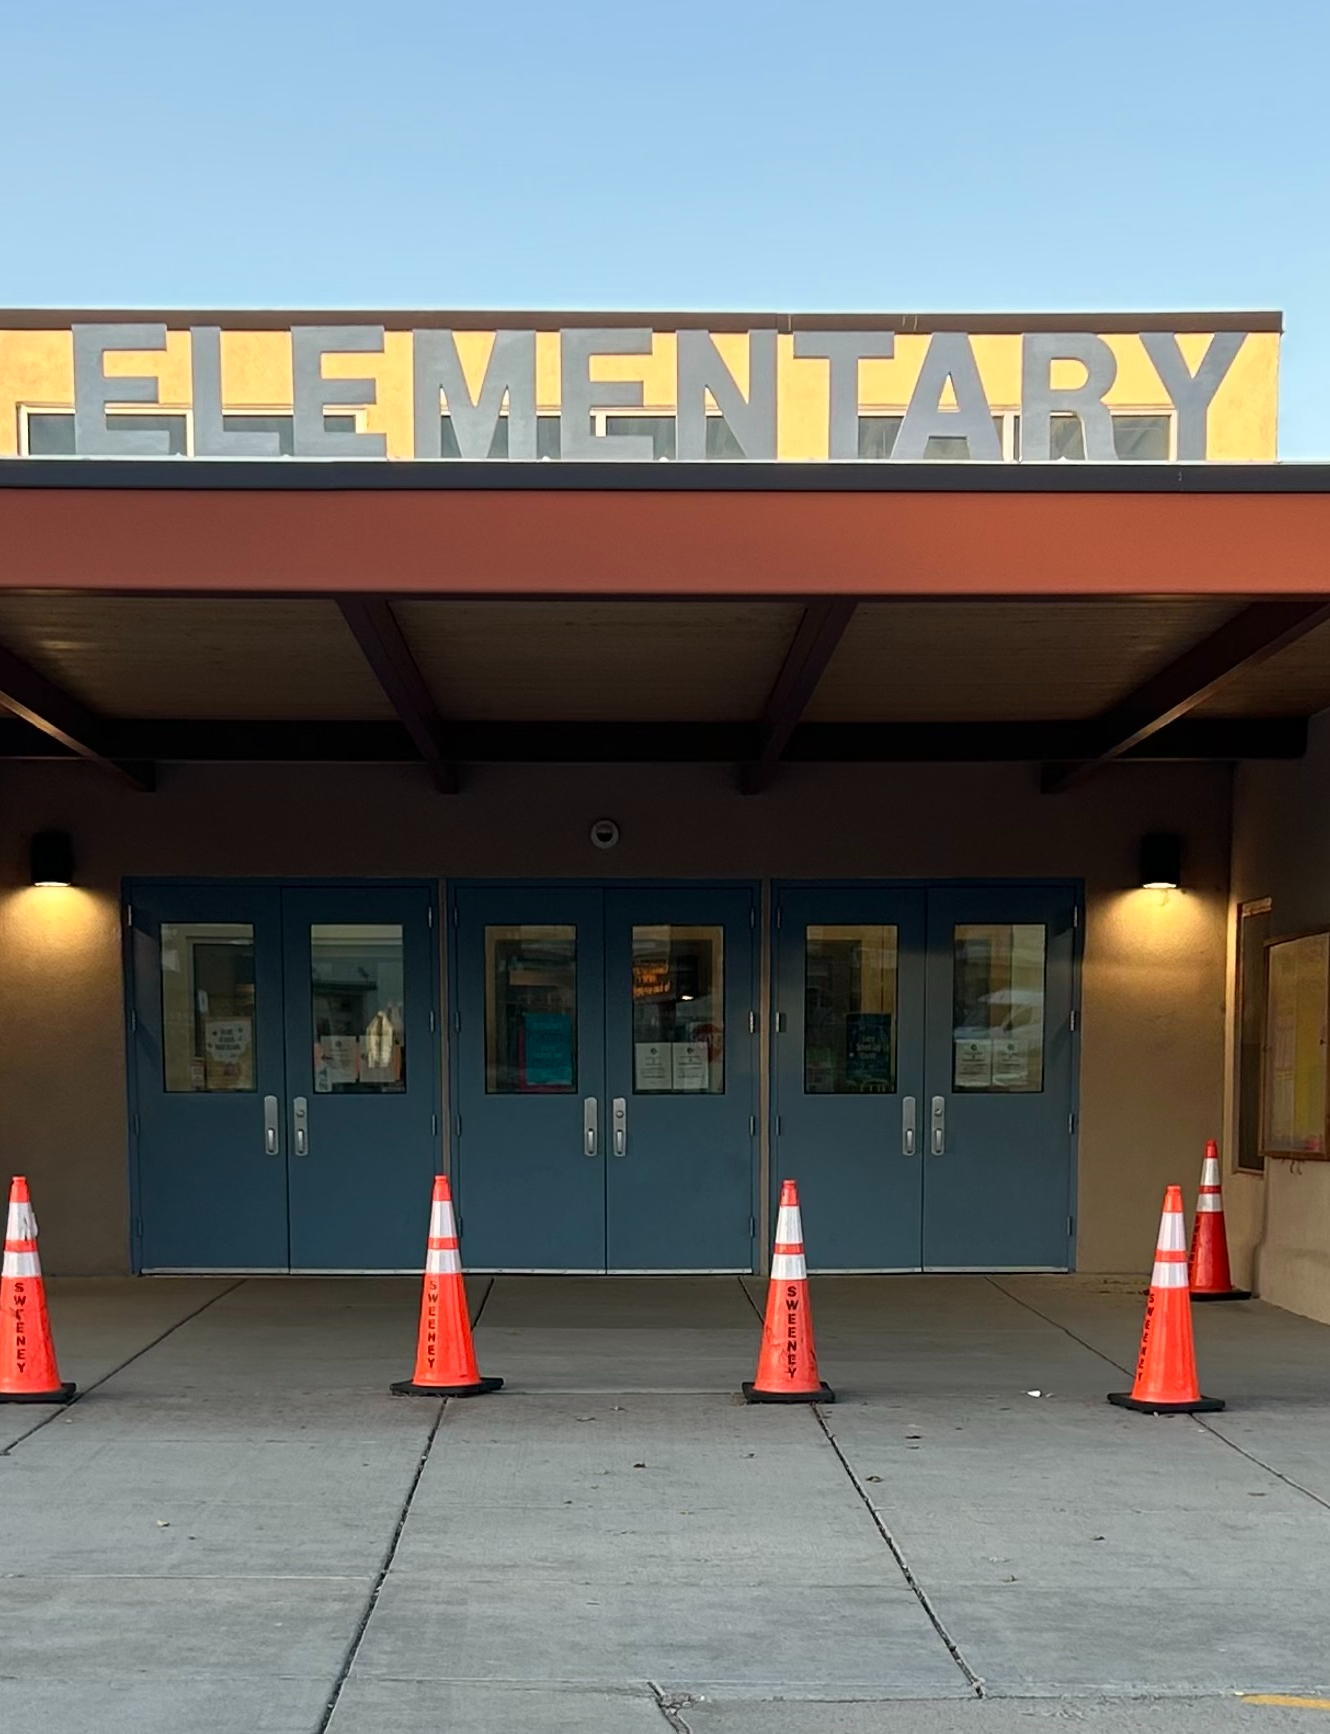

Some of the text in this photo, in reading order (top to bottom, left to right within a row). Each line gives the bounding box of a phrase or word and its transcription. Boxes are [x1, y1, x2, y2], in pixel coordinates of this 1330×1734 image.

[71, 324, 1247, 461] ELEMENTARY
[14, 1282, 27, 1374] SWEENEY
[427, 1280, 439, 1369] SWEENEY
[785, 1285, 800, 1379] SWEENEY
[1138, 1293, 1155, 1381] SWEENEY
